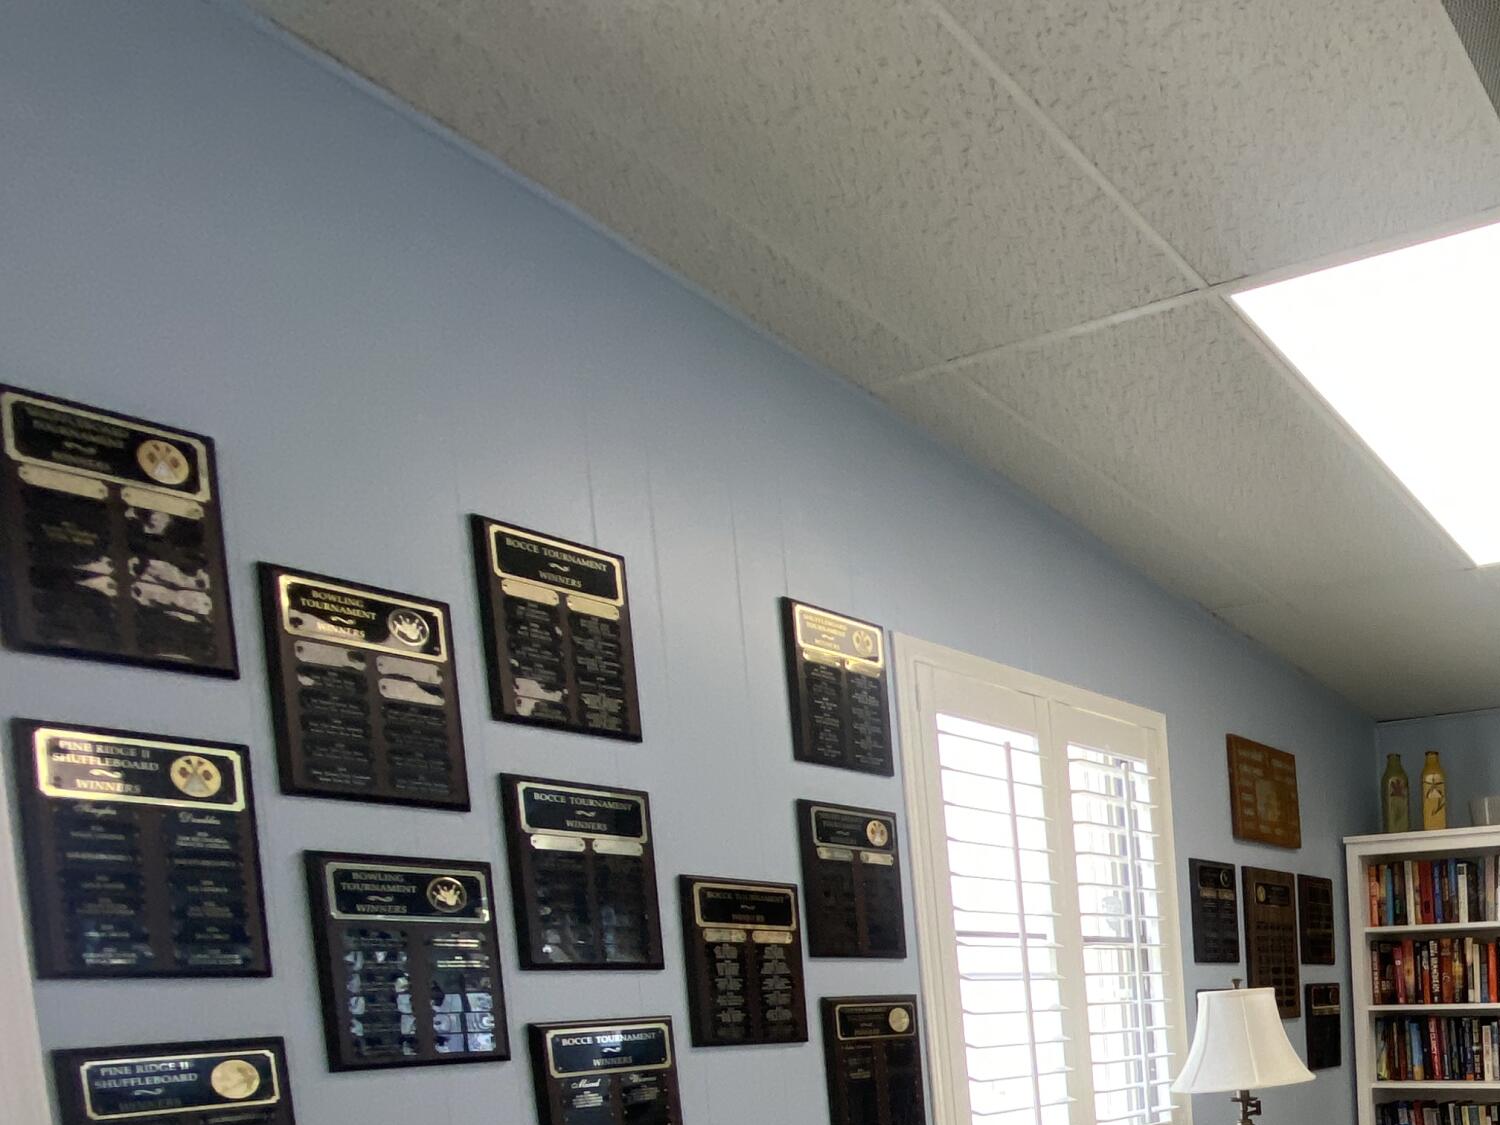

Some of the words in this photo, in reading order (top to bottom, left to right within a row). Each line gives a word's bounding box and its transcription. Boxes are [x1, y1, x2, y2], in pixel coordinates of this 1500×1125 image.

[505, 538, 539, 553] BOCCE
[542, 547, 607, 571] TOURNAMENT
[538, 570, 582, 587] WINNERS
[311, 589, 364, 608] BOWLING
[301, 598, 377, 620] TOURNAMENT
[316, 621, 365, 638] WINNERS
[58, 740, 93, 752] PINE
[95, 744, 138, 757] RIDGE
[52, 753, 159, 771] SHUFFLEBOARD
[76, 778, 141, 794] WINNERS
[533, 792, 566, 803] BOCCE
[569, 796, 633, 811] TOURNAMENT
[565, 819, 608, 831] WINNERS
[352, 872, 404, 882] BOWLING
[341, 882, 417, 894] TOURNAMENT
[356, 903, 407, 914] WINNERS
[561, 1036, 593, 1047] BOCCE
[596, 1032, 656, 1044] TOURNAMENT
[592, 1056, 633, 1067] WINNERS
[99, 1066, 132, 1077] PINE
[135, 1063, 177, 1074] RIDGE
[94, 1073, 198, 1089] SHUFFLEBOARD
